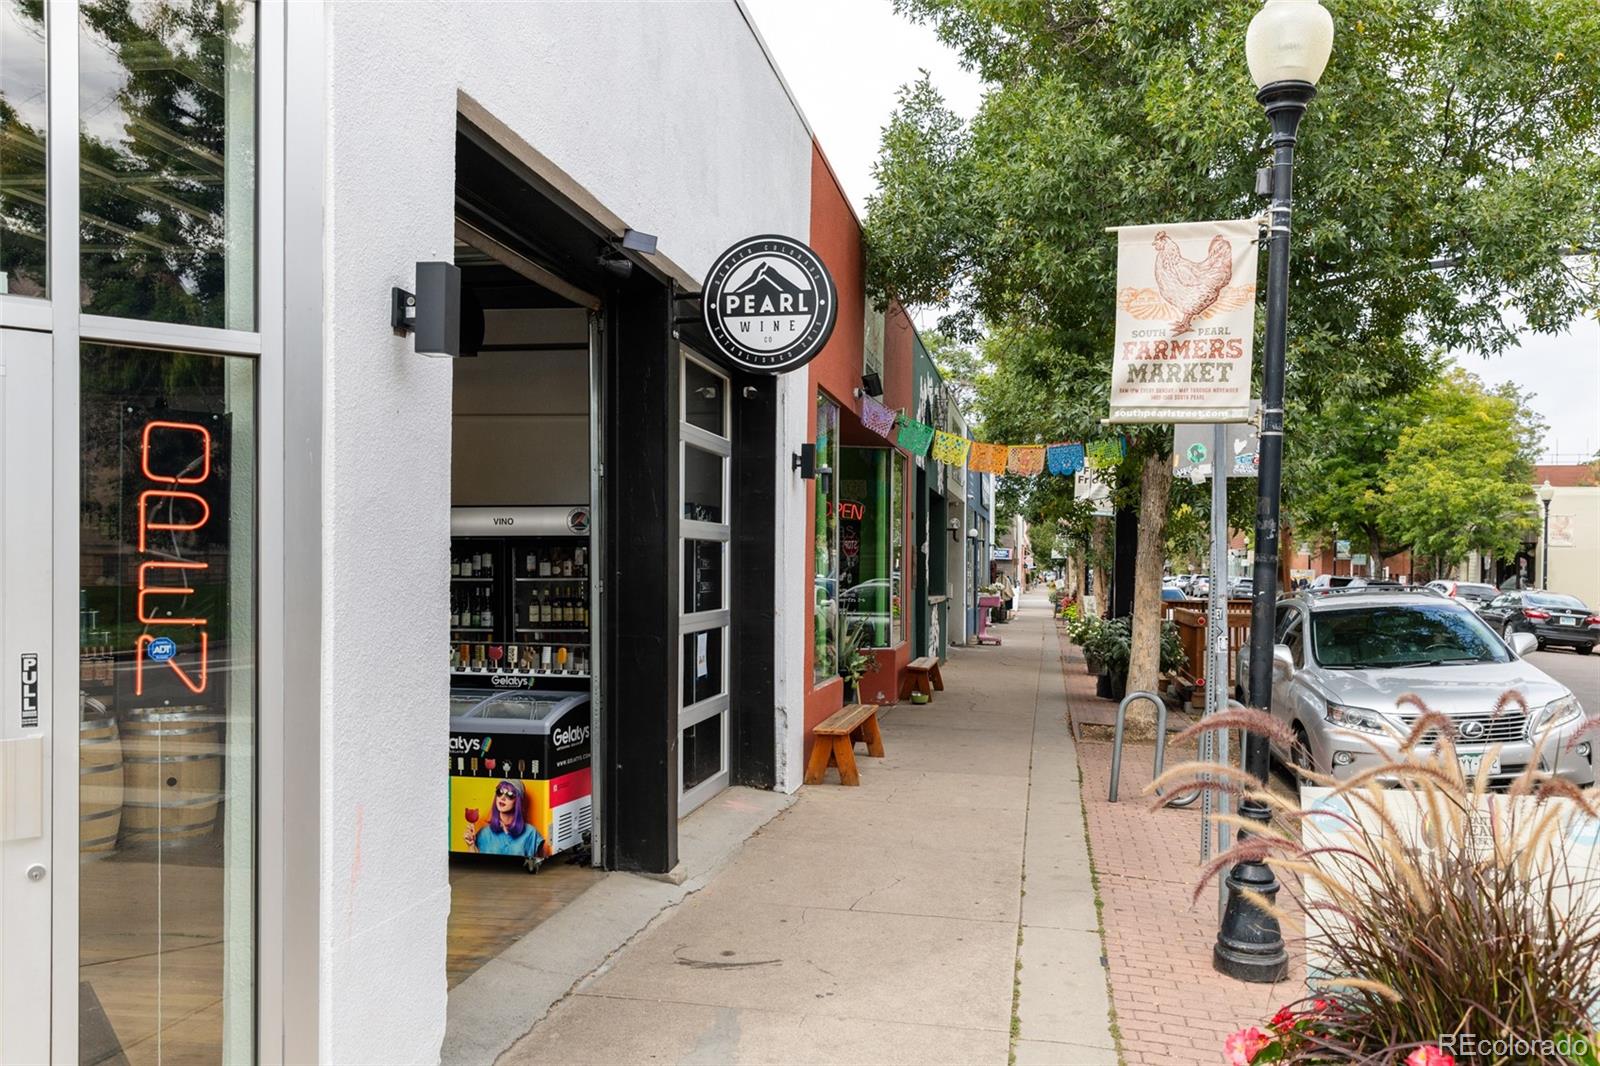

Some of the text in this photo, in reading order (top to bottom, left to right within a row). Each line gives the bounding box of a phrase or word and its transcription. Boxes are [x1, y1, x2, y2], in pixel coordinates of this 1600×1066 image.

[714, 244, 821, 285] DENVER COLORADO
[726, 293, 809, 314] PEARL
[740, 320, 796, 333] WINE
[1132, 326, 1232, 339] SOUTH PEARL
[714, 326, 794, 363] ESTABLISHED
[1122, 338, 1244, 361] FARMERS
[1126, 362, 1234, 384] MARKET
[1114, 408, 1229, 419] southpearlstreet.com
[493, 517, 514, 526] VINO
[136, 421, 211, 696] OPEN
[153, 644, 172, 654] ADT
[22, 658, 37, 711] PULL
[491, 675, 528, 688] Gelatys
[449, 735, 481, 754] atys
[552, 725, 590, 746] Gelatys
